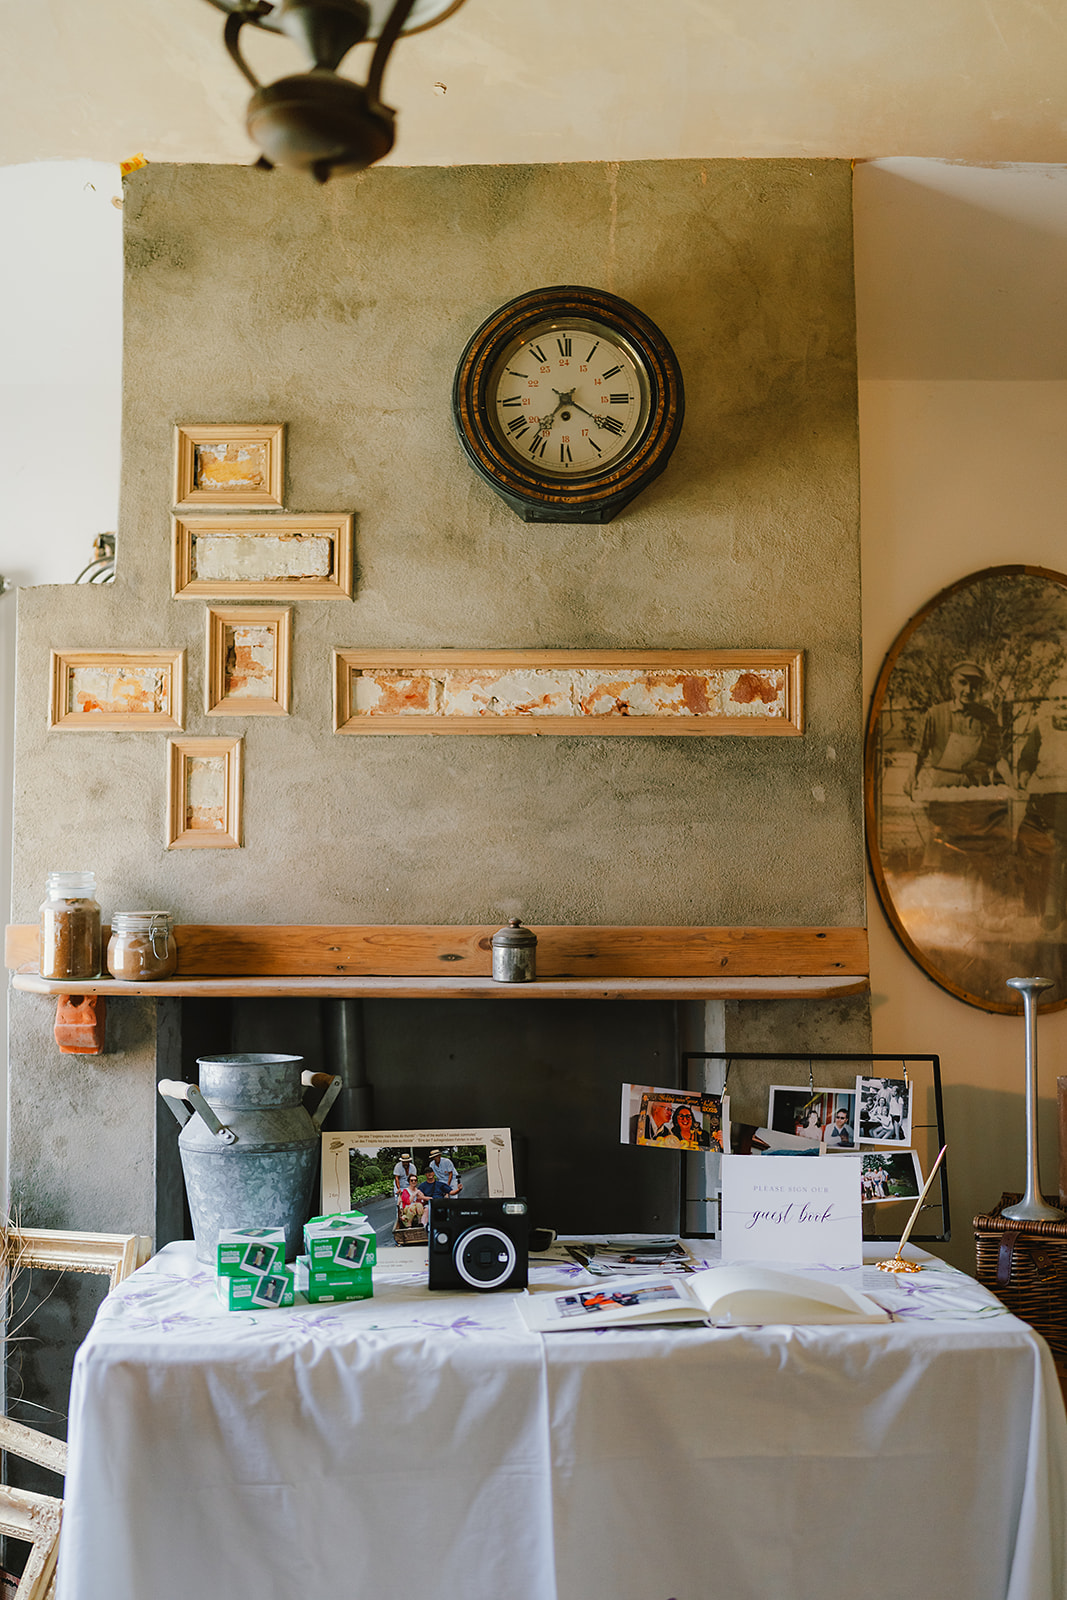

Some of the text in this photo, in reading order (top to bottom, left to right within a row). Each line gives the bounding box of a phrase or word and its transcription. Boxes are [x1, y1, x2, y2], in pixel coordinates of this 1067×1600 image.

[558, 359, 570, 367] 24
[528, 380, 539, 388] 22
[594, 378, 602, 386] 14
[522, 397, 531, 406] 21
[528, 416, 539, 424] 20
[542, 430, 551, 438] 19
[581, 428, 589, 437] 17
[561, 435, 570, 443] 18
[788, 1185, 808, 1193] SIGN
[745, 1202, 835, 1229] guest book
